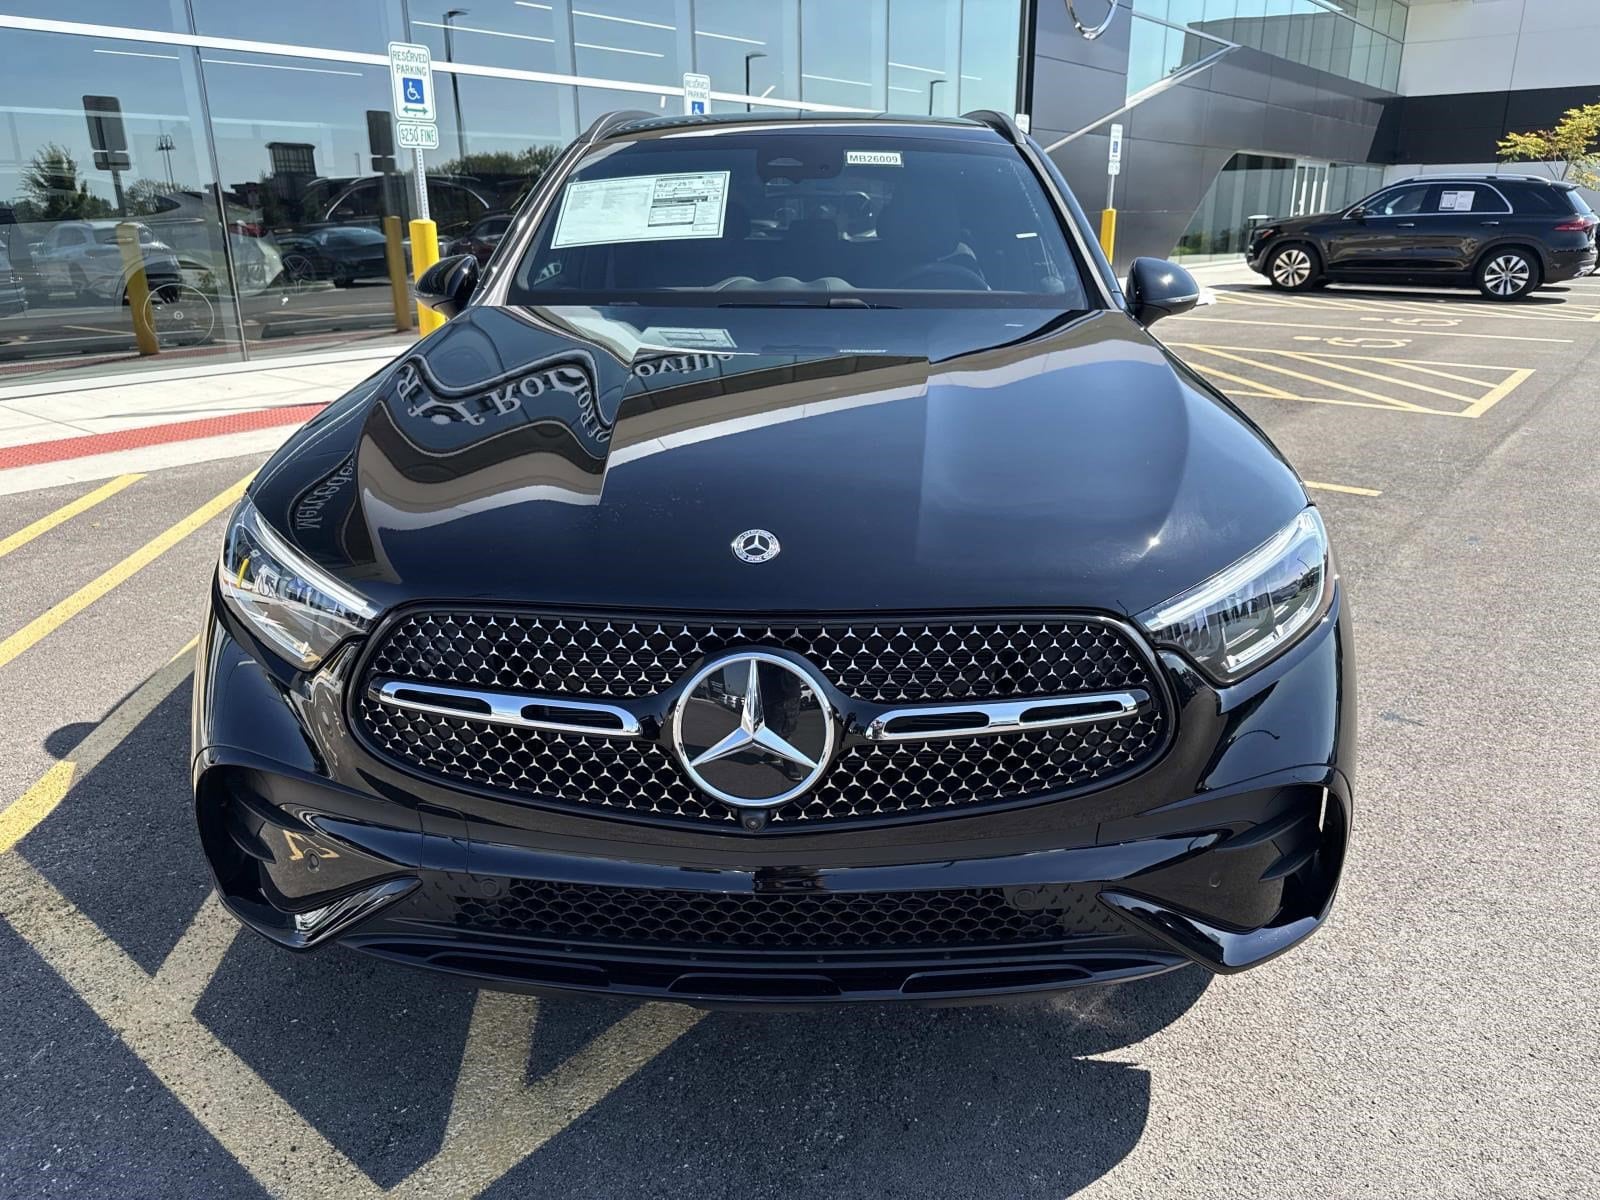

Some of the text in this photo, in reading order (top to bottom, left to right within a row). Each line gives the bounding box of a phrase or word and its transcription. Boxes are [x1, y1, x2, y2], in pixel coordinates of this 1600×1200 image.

[392, 50, 428, 64] RESERVED
[396, 63, 427, 77] PARKING
[400, 128, 435, 143] $250 FINE
